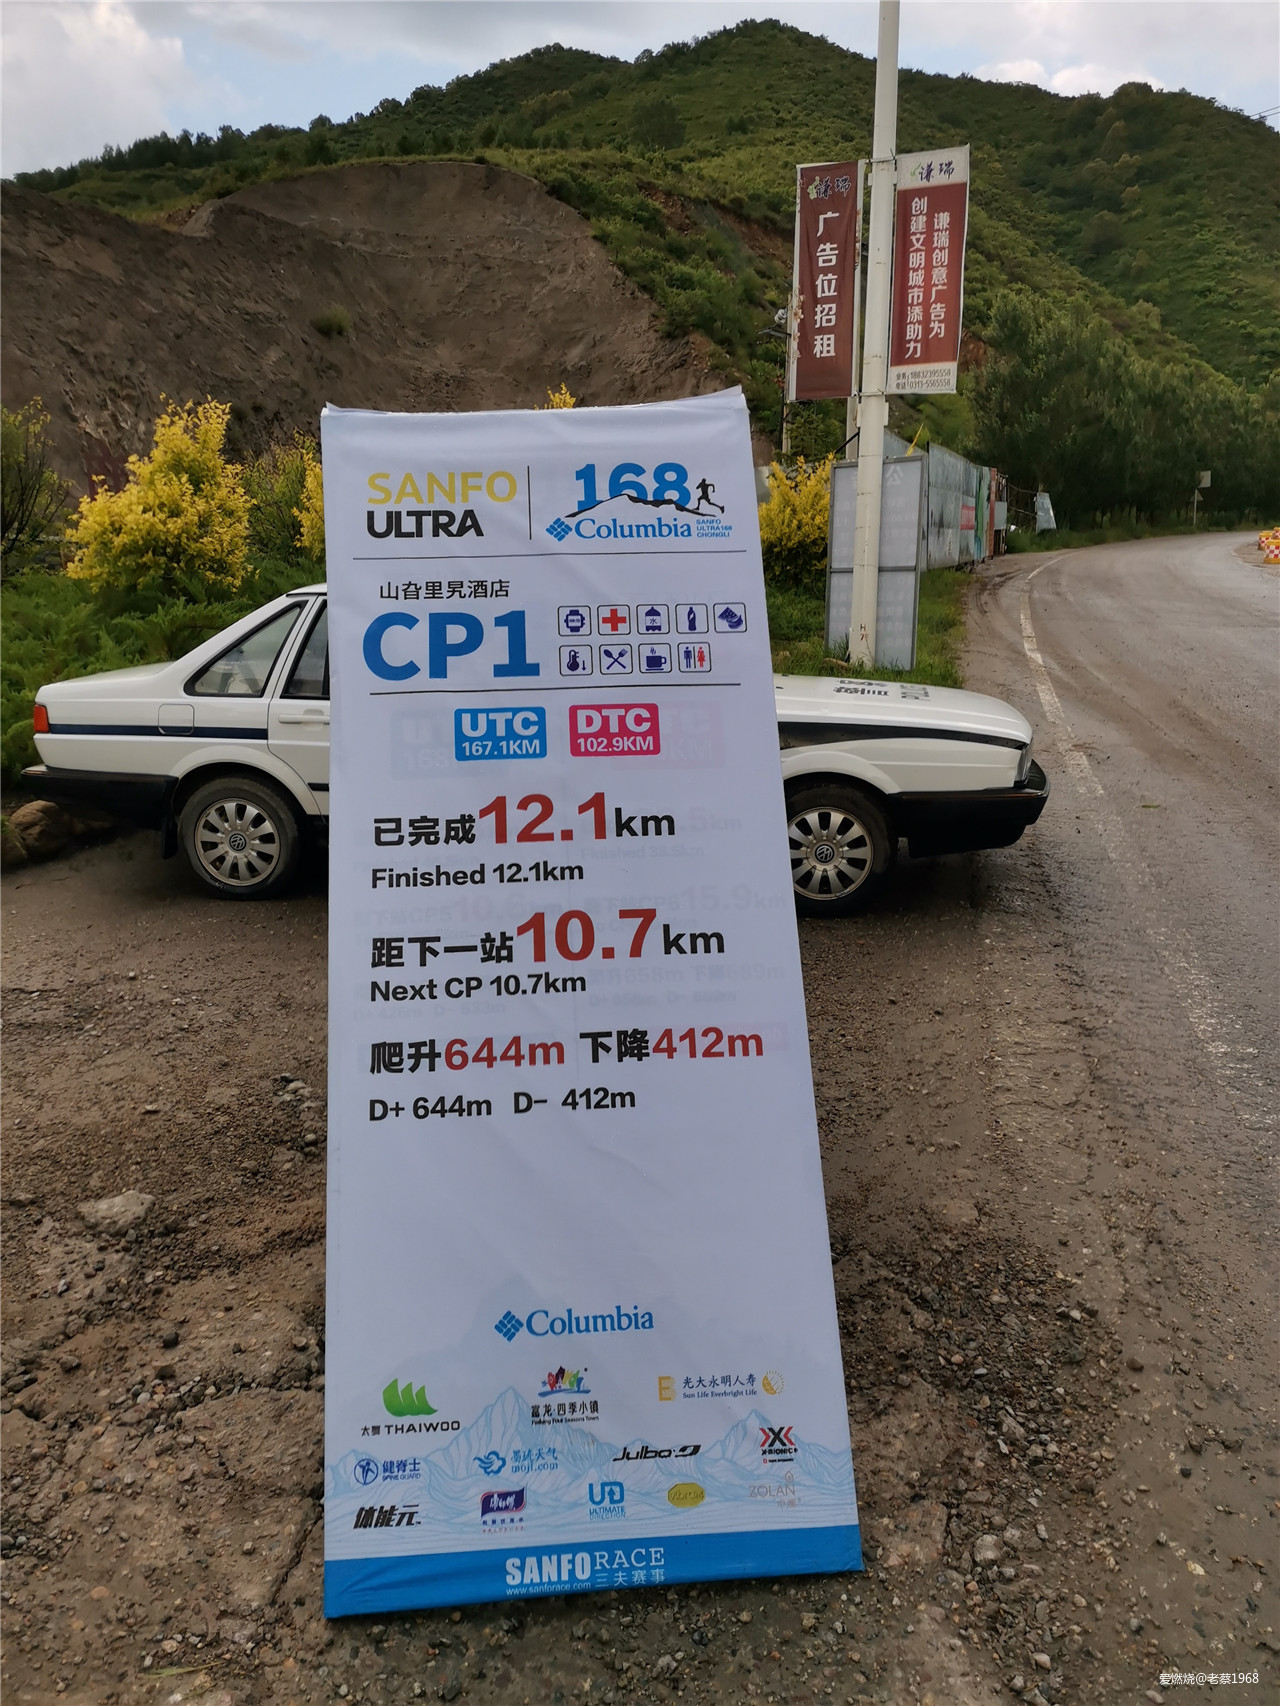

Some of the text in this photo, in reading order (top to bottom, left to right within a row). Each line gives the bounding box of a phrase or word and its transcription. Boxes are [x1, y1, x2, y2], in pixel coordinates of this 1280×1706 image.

[813, 211, 841, 360] 广告位招租
[905, 196, 928, 360] 创建文明城市添助力
[929, 212, 951, 340] 谦瑞创意广告为
[367, 470, 518, 505] SANFO
[575, 462, 692, 511] 168
[366, 509, 485, 539] ULTRA
[574, 516, 693, 541] Columbia
[696, 531, 731, 539] CHONGLI
[379, 579, 511, 601] 山旮里旯酒店
[362, 609, 541, 682] CP1
[460, 711, 539, 737] UTC
[576, 709, 652, 734] DTC
[461, 740, 541, 757] 167.1KM
[576, 735, 654, 753] 102.9KM
[372, 790, 677, 847] 已完成12.1km
[371, 860, 584, 889] Finished 12.1km
[371, 907, 726, 969] 距下一站10.7km
[370, 971, 587, 1002] Next CP 10.7km
[369, 1034, 566, 1075] 爬升644m
[580, 1025, 765, 1065] 下降412m
[369, 1099, 405, 1122] D+
[412, 1095, 493, 1120] 644m
[561, 1086, 637, 1111] 412m
[526, 1304, 655, 1338] Columbia
[682, 1373, 758, 1390] 光大永明人寿
[682, 1387, 758, 1399] Sun Life Everbright Life
[384, 1420, 461, 1436] THAIWOO
[564, 1416, 585, 1424] Seasons
[382, 1457, 422, 1475] 健脊士
[511, 1462, 559, 1474] moji.com
[749, 1484, 796, 1498] ZOLAN
[353, 1504, 420, 1530] 体能元
[588, 1506, 626, 1515] ULTIMATE
[589, 1511, 627, 1521] DIRECTION
[505, 1547, 666, 1586] SANFO RACE
[595, 1568, 667, 1588] 三夫赛事
[505, 1580, 592, 1597] www.sanforace.com
